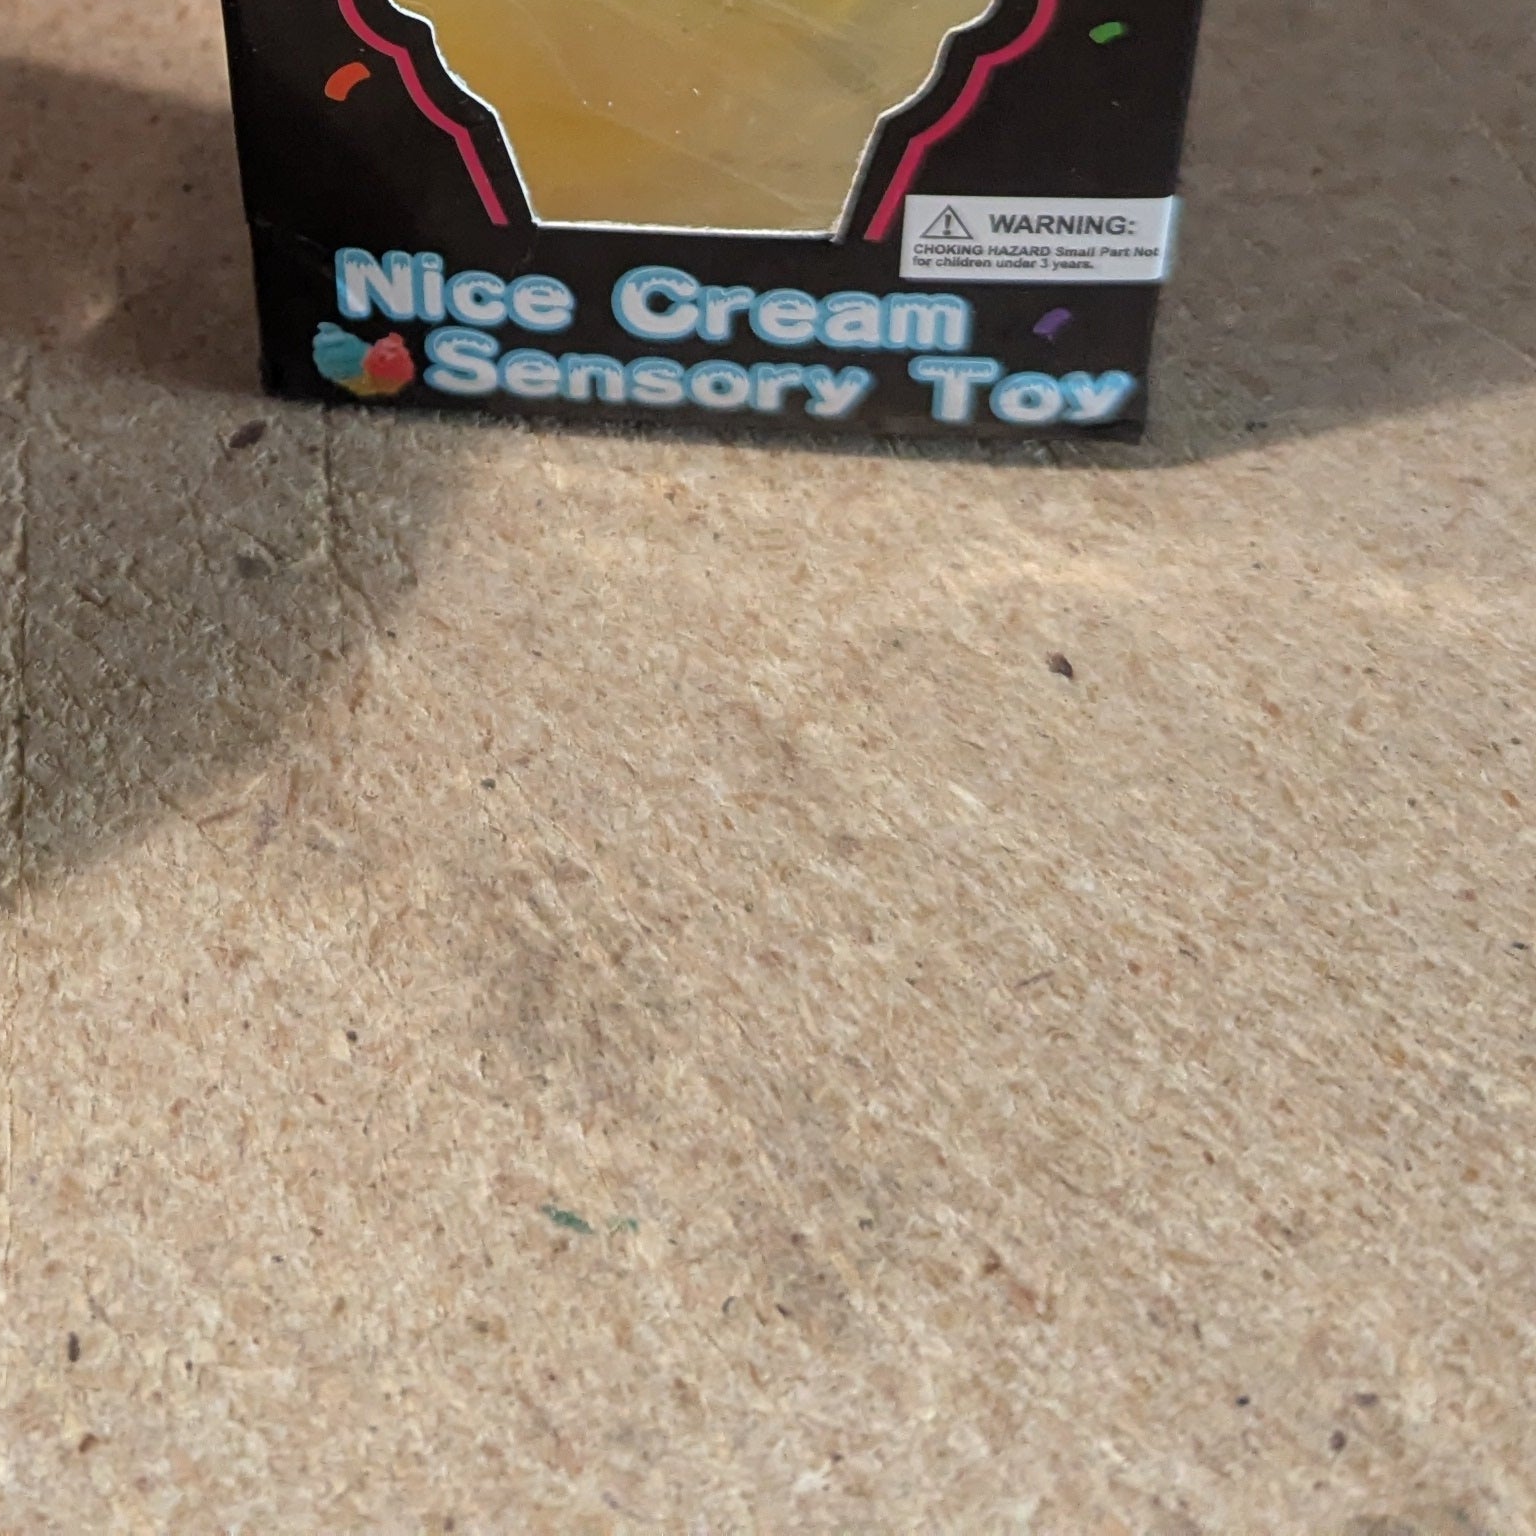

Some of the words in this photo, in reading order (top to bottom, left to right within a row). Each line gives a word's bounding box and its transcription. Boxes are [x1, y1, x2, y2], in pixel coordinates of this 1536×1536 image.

[989, 213, 1136, 235] WARNING:
[913, 243, 983, 256] CHOKING
[987, 245, 1051, 257] HAZARD
[1054, 245, 1095, 257] Small
[1099, 246, 1130, 257] Part
[1133, 246, 1159, 257] Not
[912, 255, 933, 267] for
[935, 256, 992, 268] children
[996, 257, 1035, 269] under
[1039, 258, 1049, 269] 3
[334, 246, 574, 331] Nice
[611, 264, 973, 352] Cream
[423, 326, 873, 419] Sensory
[908, 354, 1135, 427] Toy
